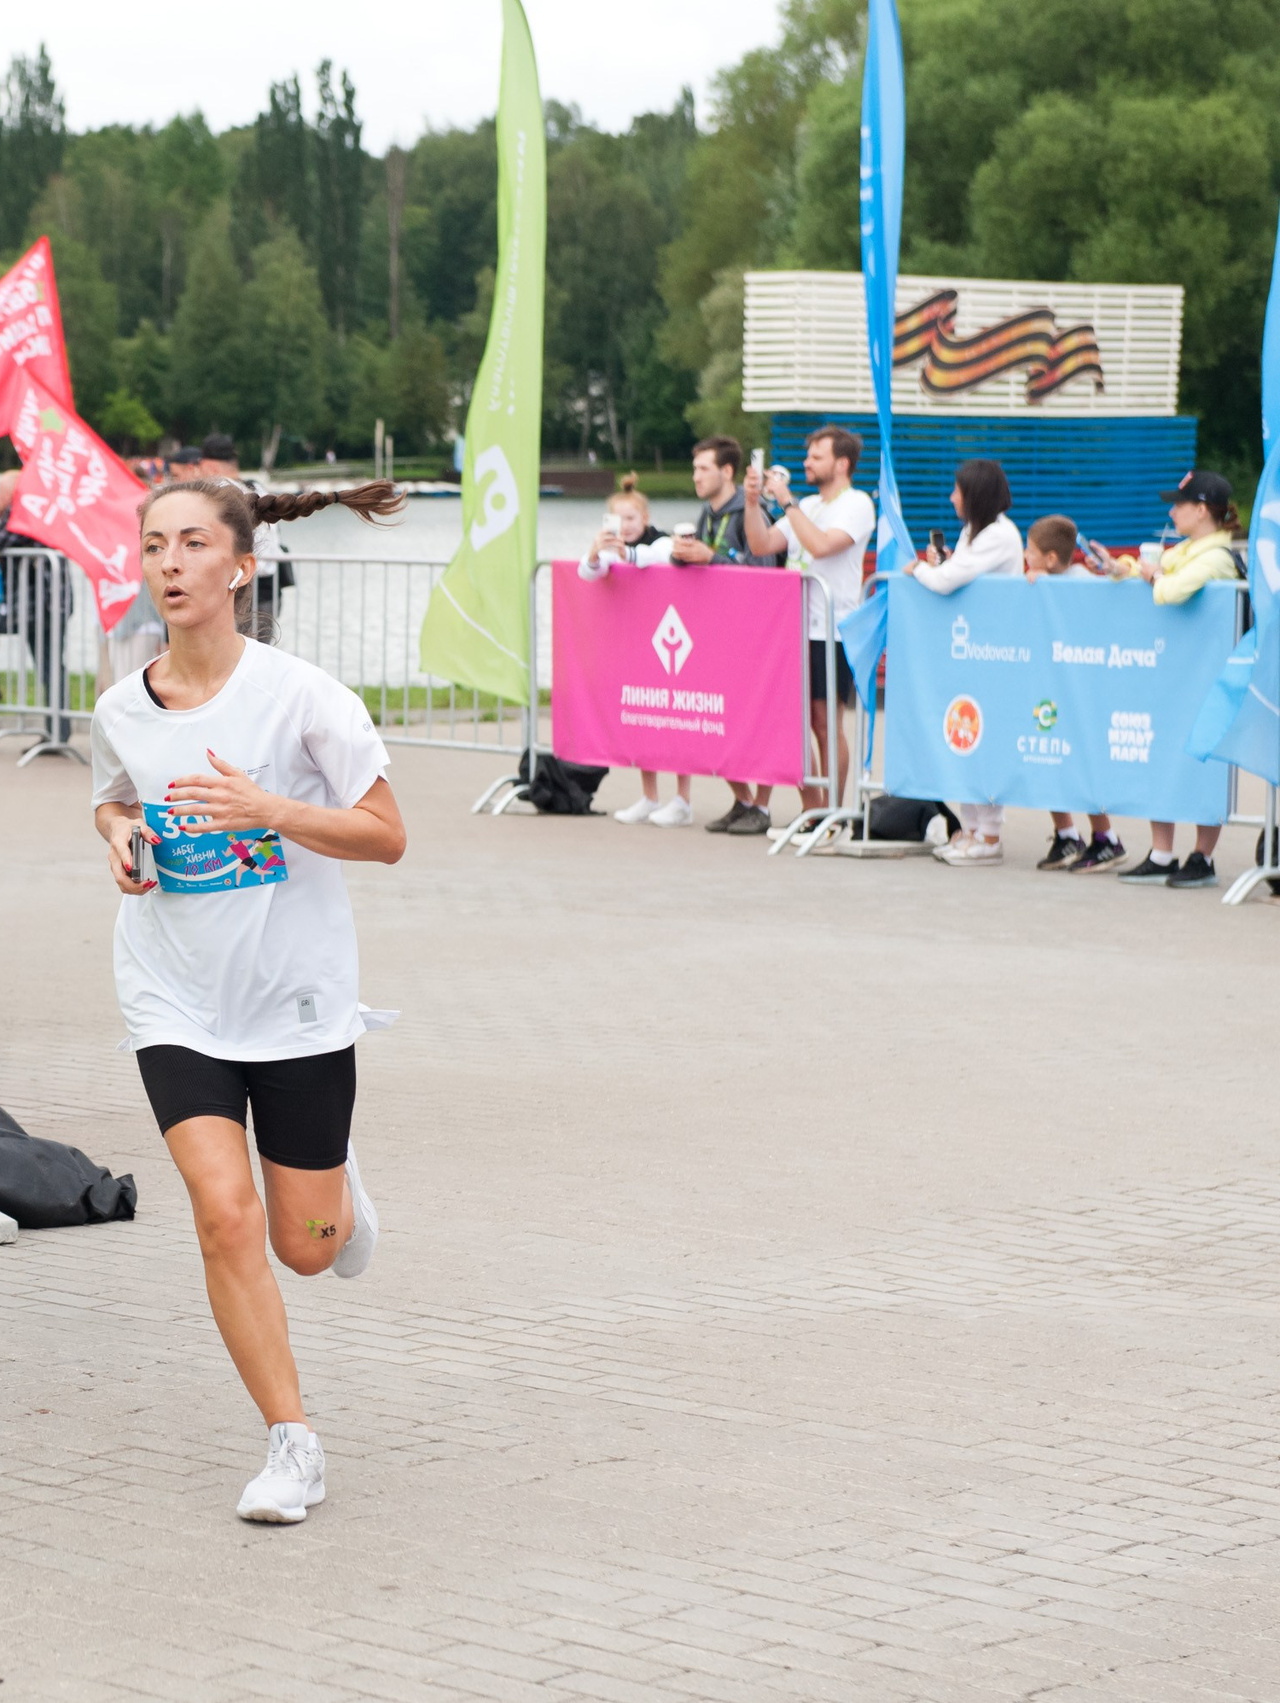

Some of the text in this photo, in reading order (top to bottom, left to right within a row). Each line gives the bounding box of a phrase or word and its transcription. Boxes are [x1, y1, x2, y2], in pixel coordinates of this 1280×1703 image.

[967, 643, 1030, 662] Vodovoz.ru
[1052, 642, 1156, 668] Белая Дача
[621, 685, 725, 715] ЛИНИЯ ЖИЗНИ
[621, 710, 726, 738] благотворительный фонд
[1111, 712, 1150, 730] СОЮЗ
[1017, 735, 1072, 756] СТЕПЬ
[1108, 728, 1153, 746] МУЛЬТ
[1110, 747, 1149, 763] ПАРК
[157, 812, 224, 839] 30
[172, 843, 195, 857] ЗАБЕГ
[184, 857, 223, 877] 10 КМ
